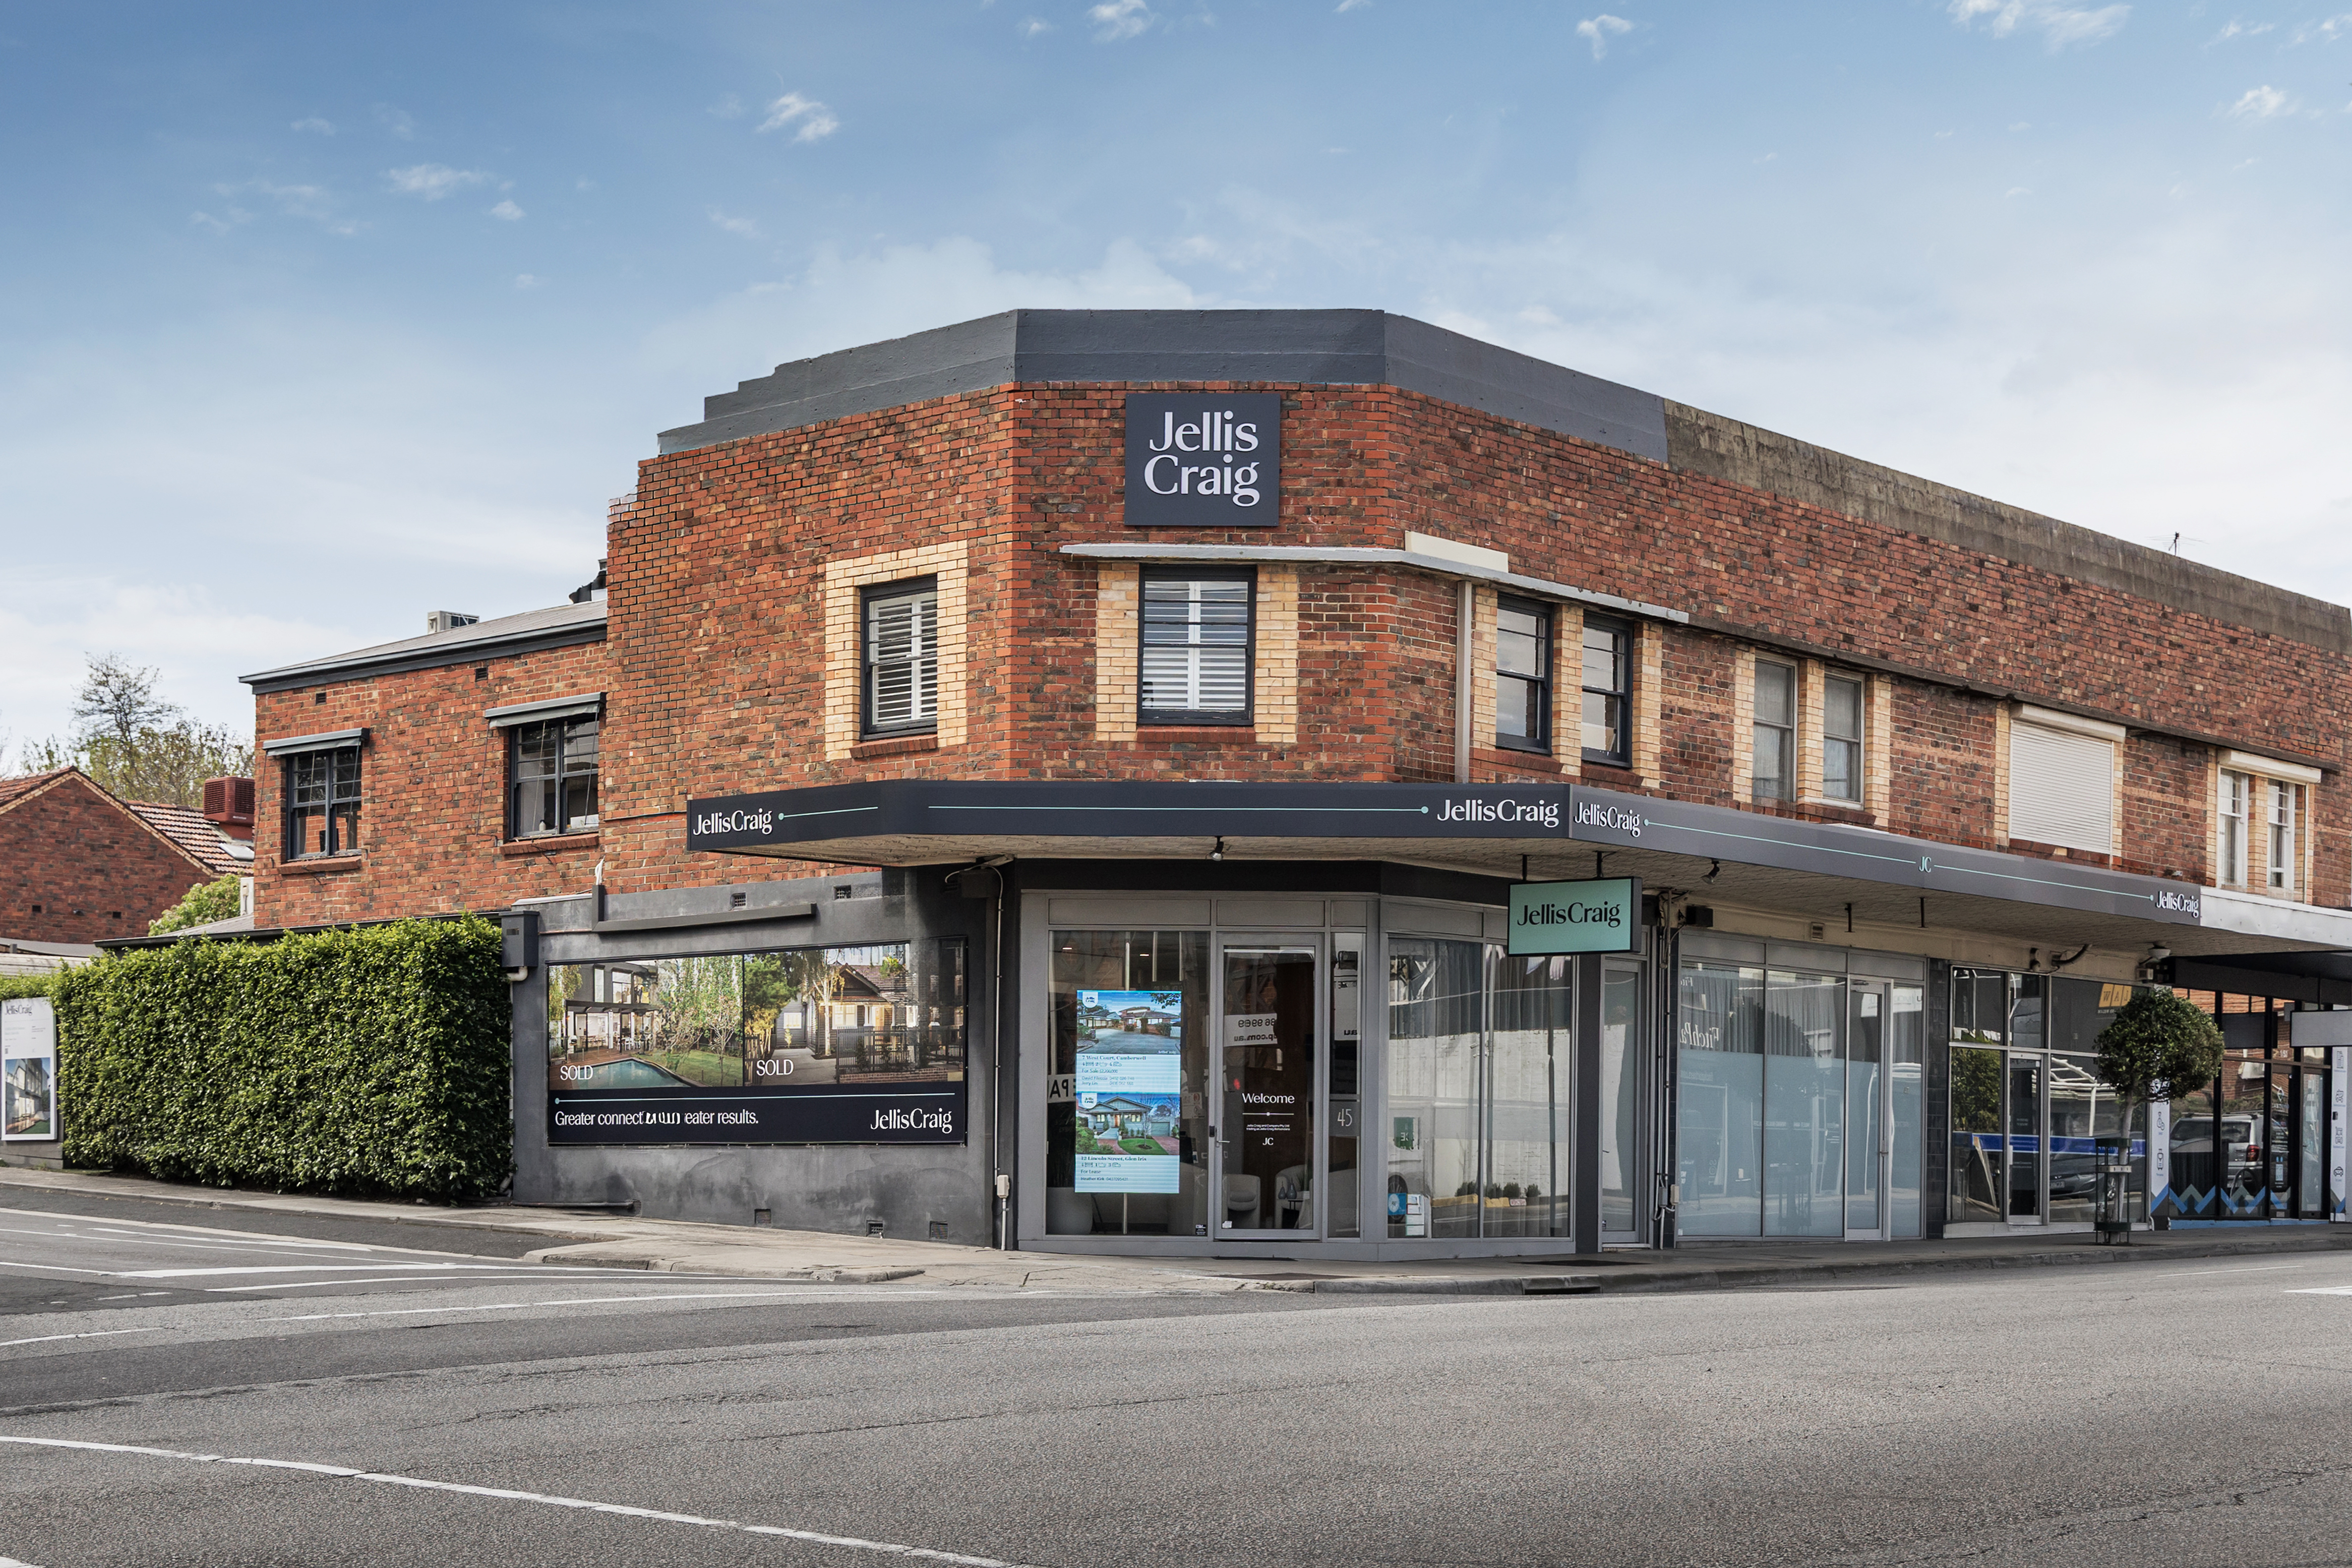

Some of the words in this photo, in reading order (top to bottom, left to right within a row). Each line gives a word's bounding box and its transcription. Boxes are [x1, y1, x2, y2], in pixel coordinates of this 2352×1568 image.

[1149, 410, 1259, 452] Jellis
[1144, 454, 1261, 507] Craig
[693, 808, 773, 836] JellisCraig
[1437, 799, 1560, 828] JellisCraig
[1574, 802, 1641, 838] JellisCraig
[1919, 856, 1932, 873] JC
[1517, 901, 1621, 928] JellisCraig
[2156, 890, 2199, 918] JellisCraig
[560, 1065, 594, 1081] SOLD
[756, 1059, 794, 1076] SOLD
[1242, 1092, 1295, 1104] Welcome
[555, 1111, 596, 1126] Greater
[717, 1108, 759, 1125] results.
[870, 1108, 953, 1134] JellisCraig
[1337, 1108, 1352, 1127] 45
[1262, 1137, 1274, 1146] JC
